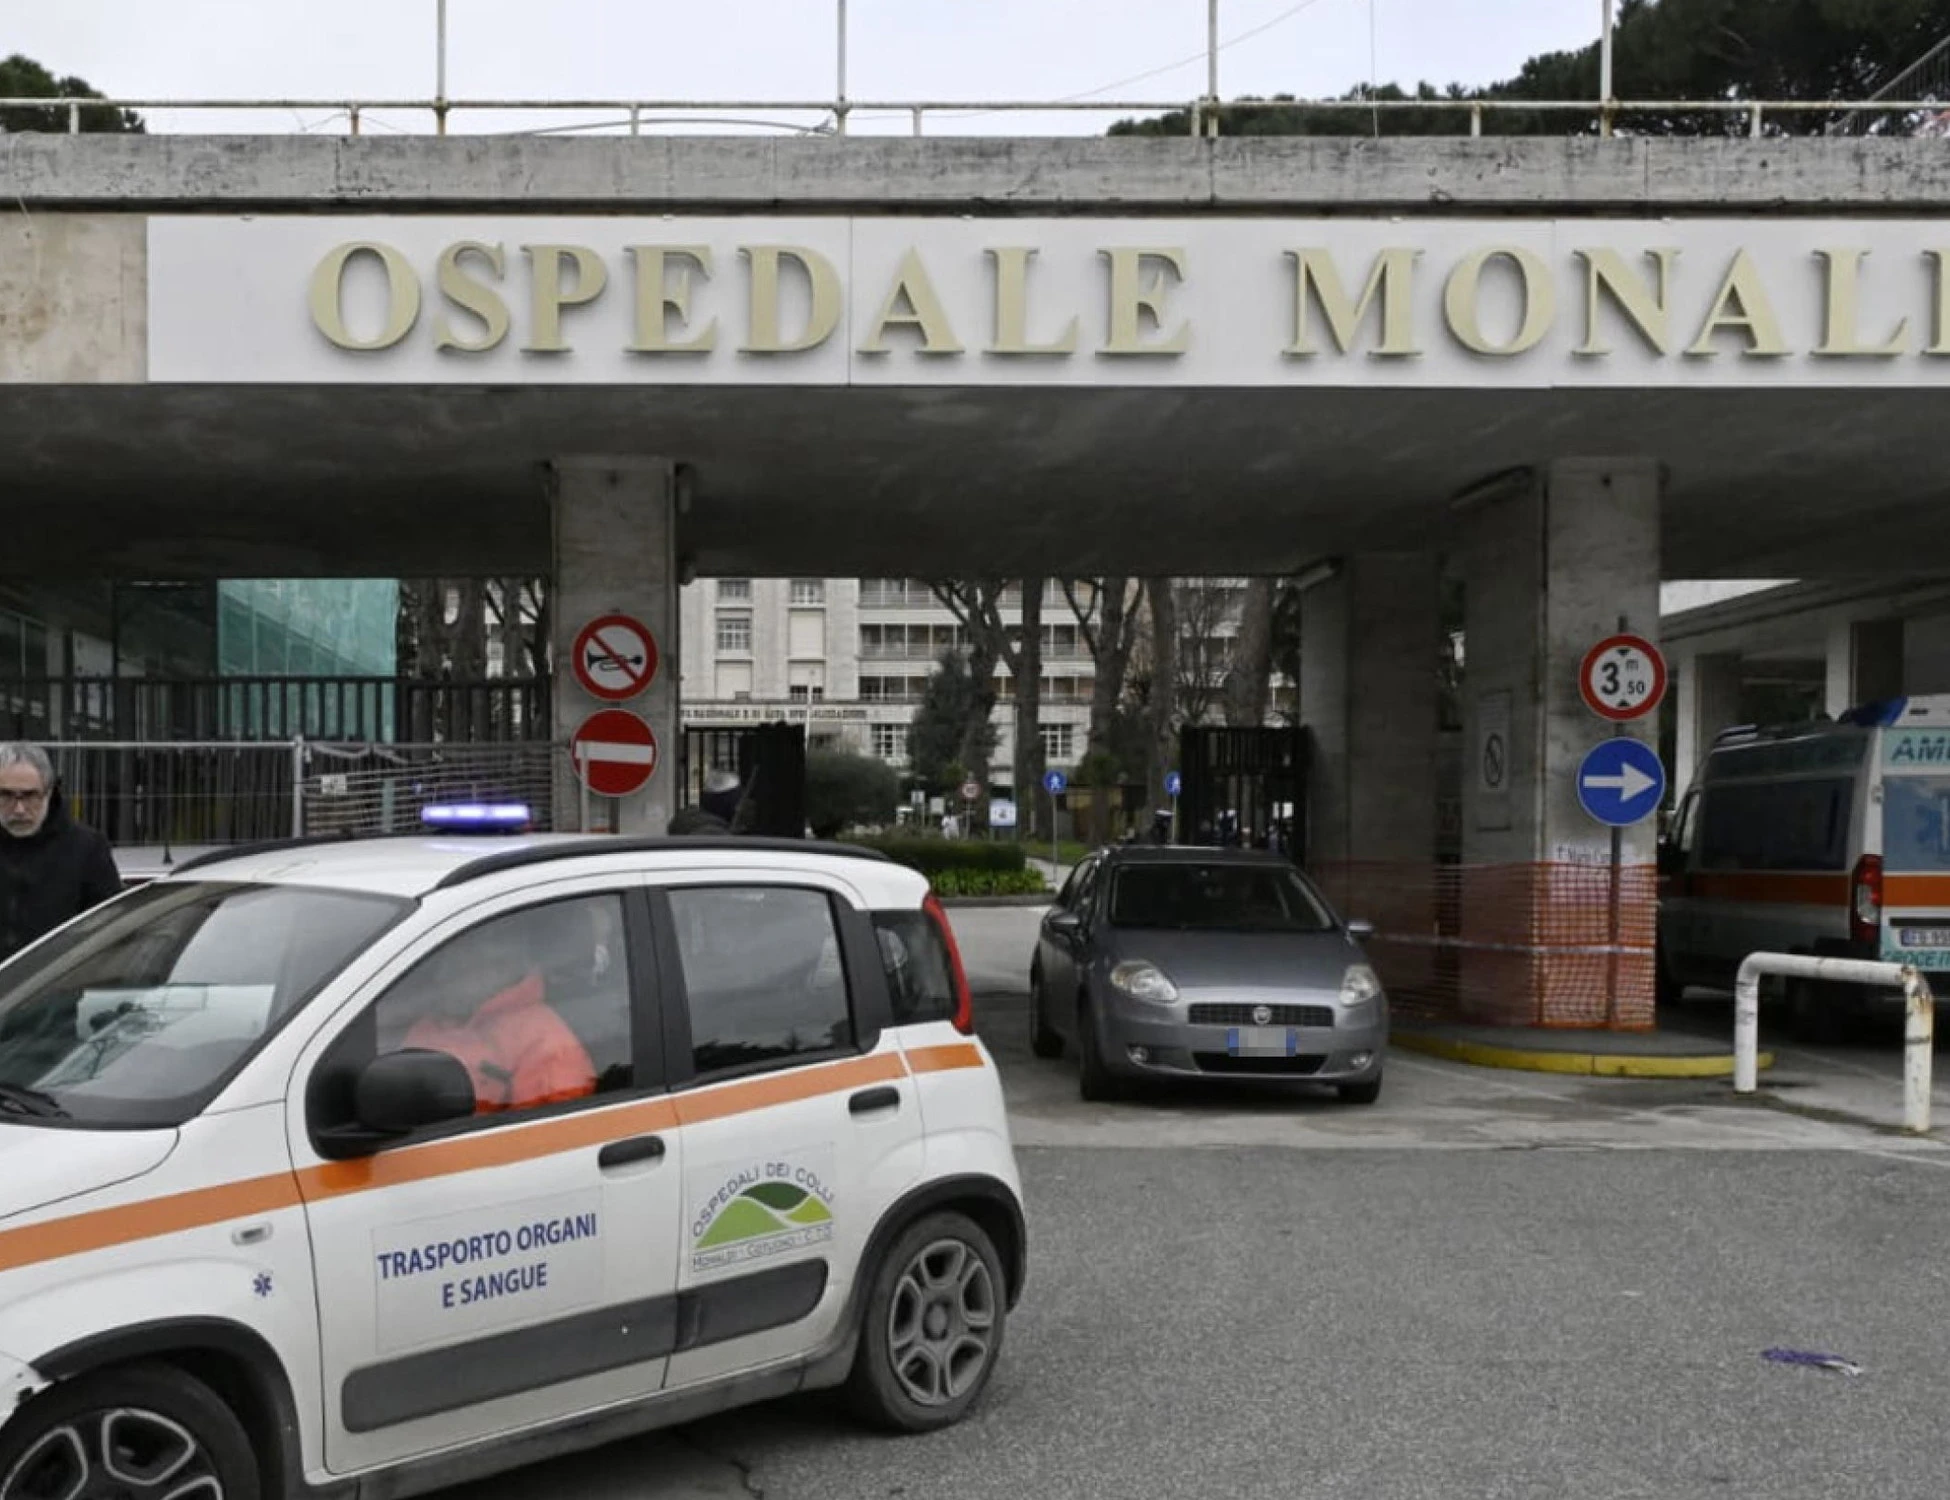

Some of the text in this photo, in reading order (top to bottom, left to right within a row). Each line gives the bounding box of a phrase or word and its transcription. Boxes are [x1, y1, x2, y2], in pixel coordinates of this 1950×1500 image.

[309, 240, 1950, 358] OSPEDALE MONAL
[1601, 661, 1620, 695] 3
[1627, 680, 1645, 695] 50
[692, 1162, 836, 1237] OSPEDALI DEI COLLI
[377, 1213, 597, 1279] TRASPORTO ORGANI
[442, 1262, 548, 1309] E SANGUE
